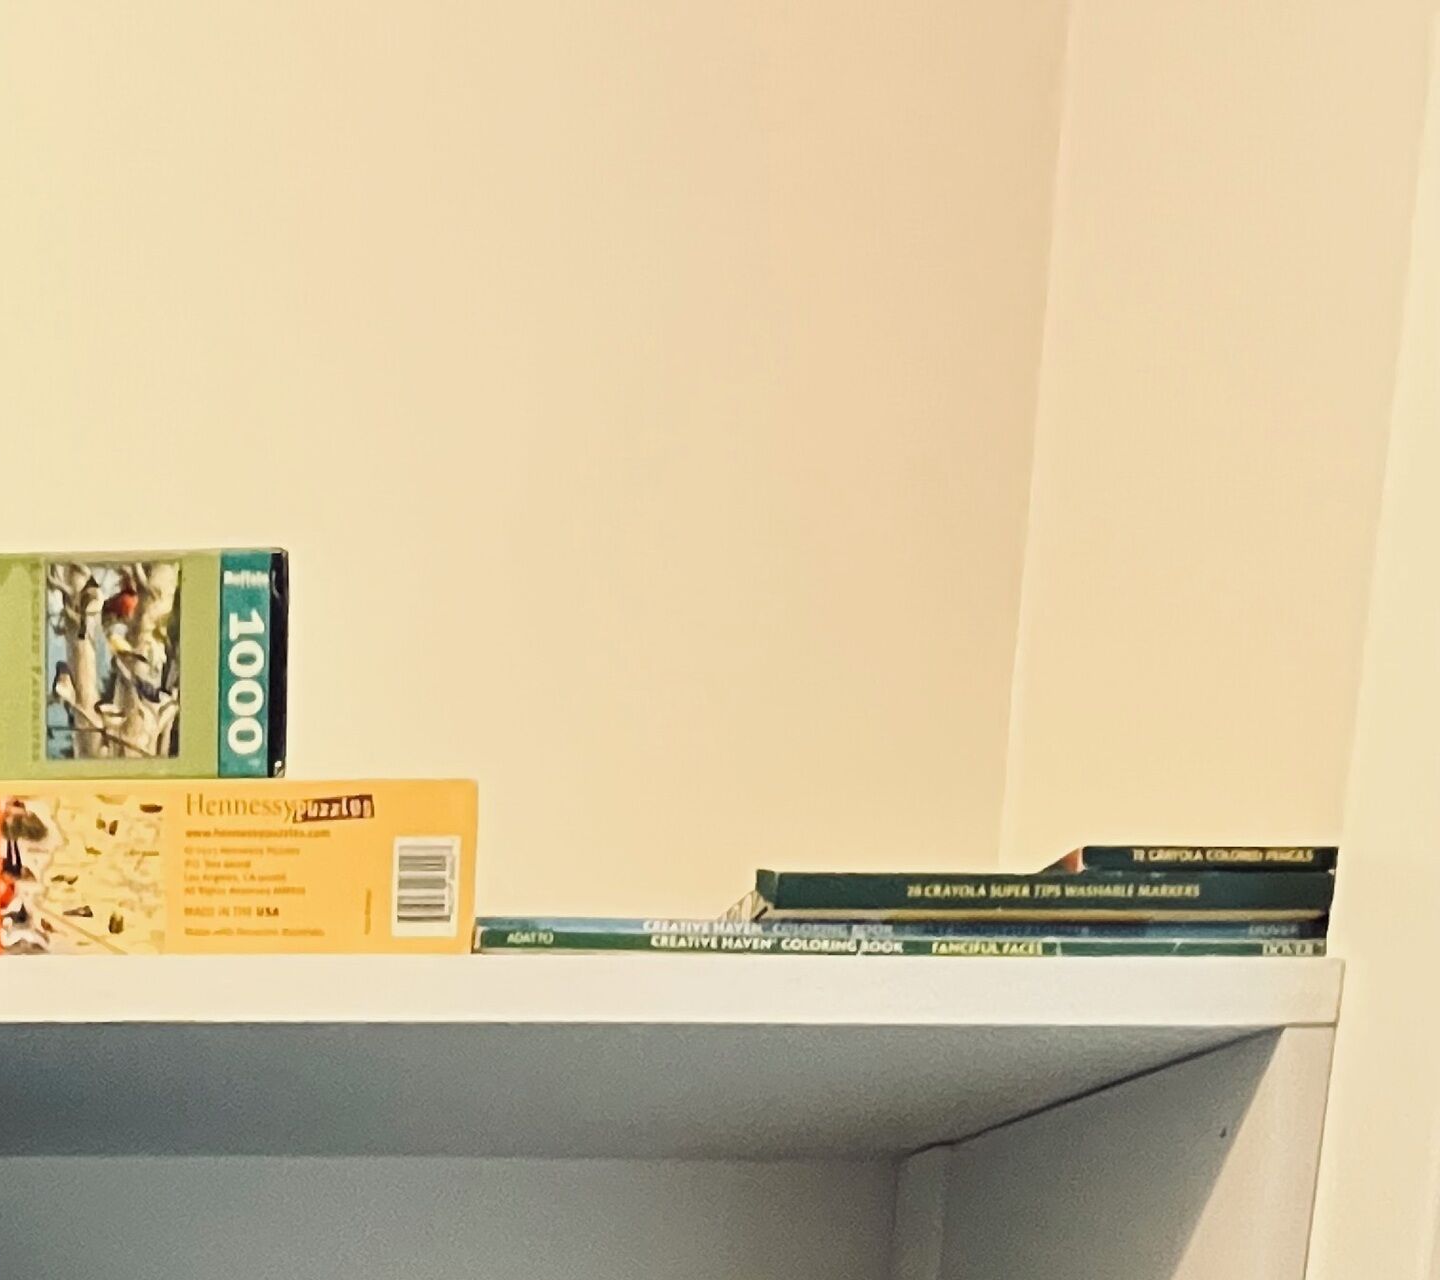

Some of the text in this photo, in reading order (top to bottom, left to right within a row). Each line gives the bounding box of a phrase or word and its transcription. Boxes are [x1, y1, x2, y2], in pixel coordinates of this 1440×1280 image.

[227, 608, 266, 755] 1000
[924, 884, 986, 898] CRAYOLA
[989, 884, 1029, 898] SUPER
[1034, 884, 1061, 897] TIPS
[1065, 884, 1134, 897] WASHABLE
[1137, 884, 1200, 897] MARKERS
[643, 920, 710, 932] CREATIVE
[650, 935, 717, 948] CREATIVE
[781, 938, 857, 952] COLORING
